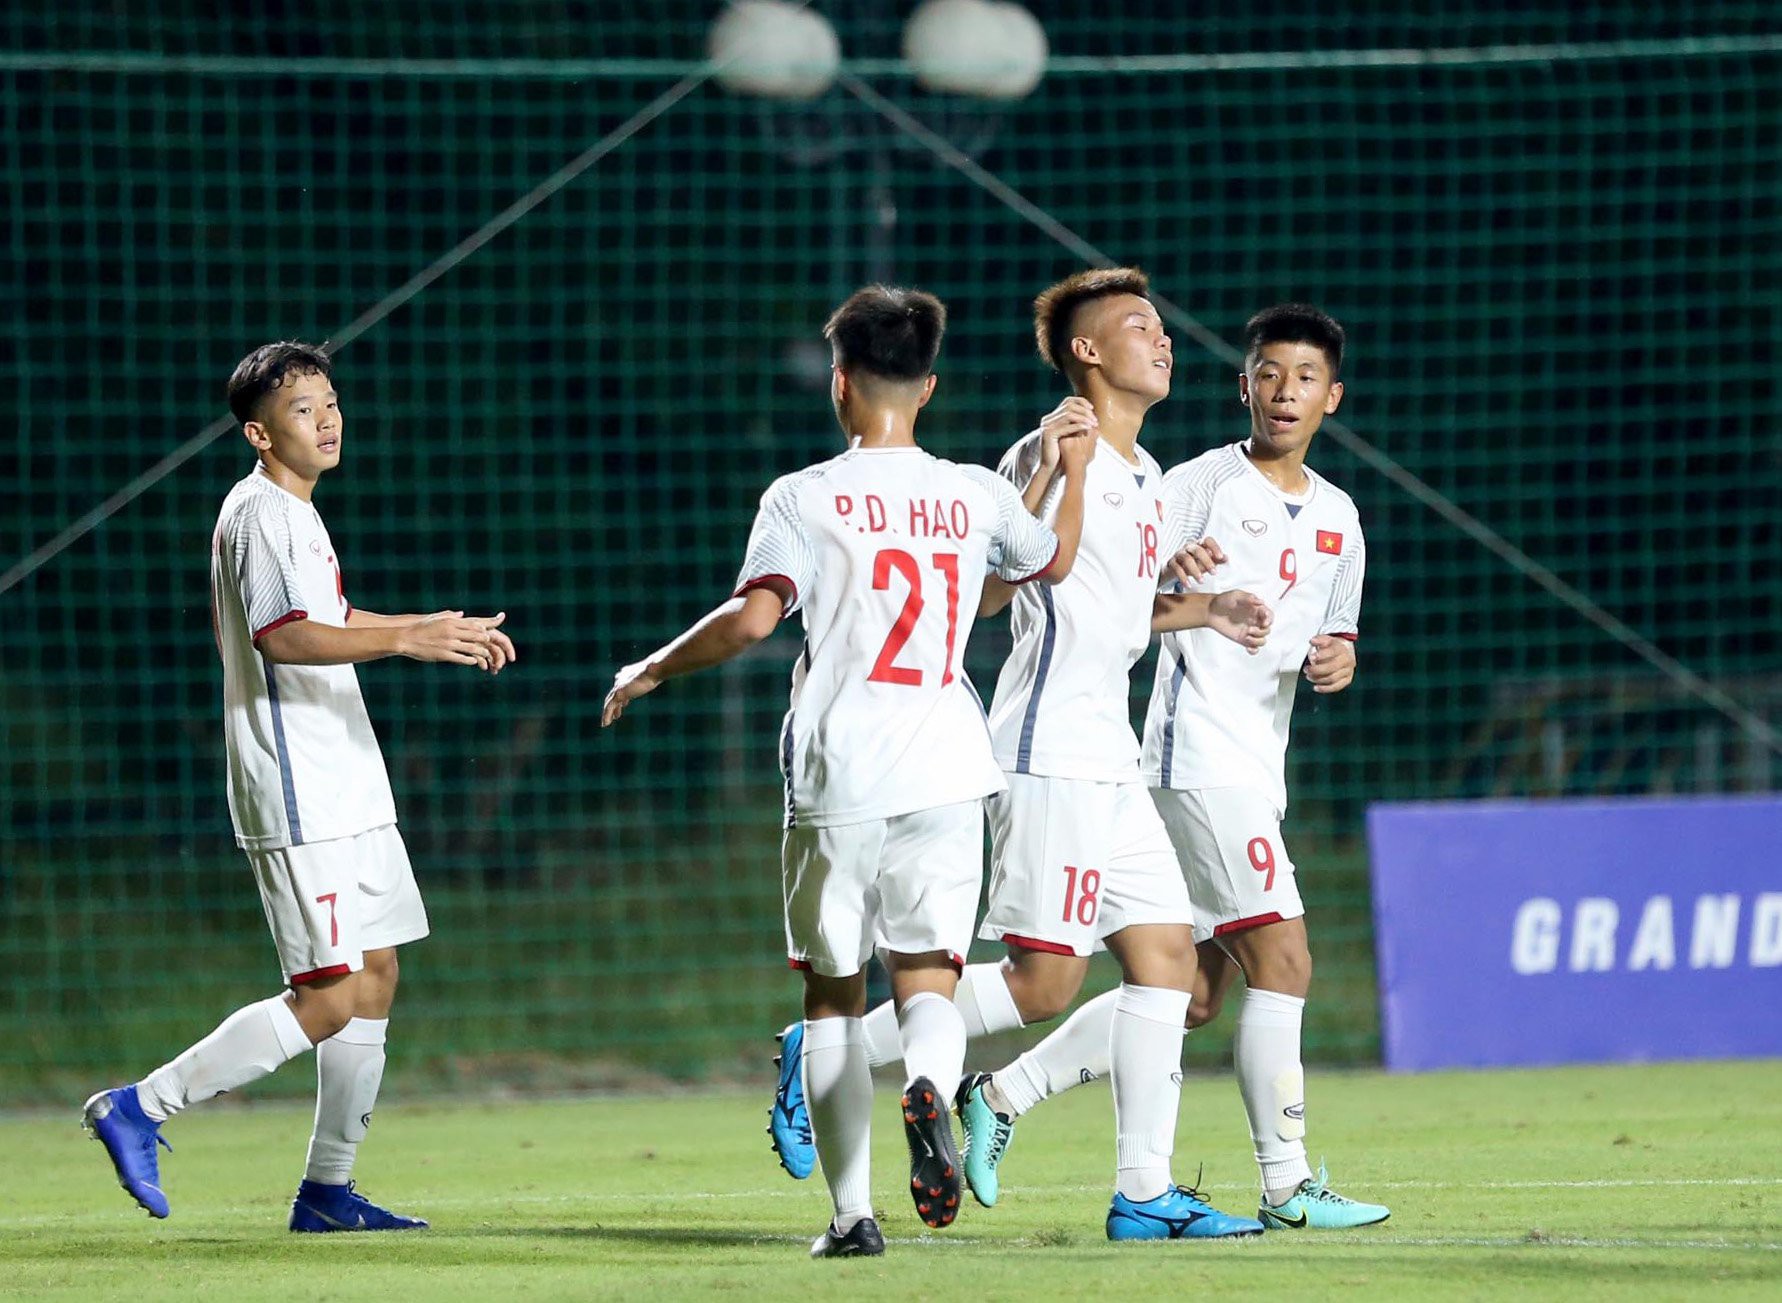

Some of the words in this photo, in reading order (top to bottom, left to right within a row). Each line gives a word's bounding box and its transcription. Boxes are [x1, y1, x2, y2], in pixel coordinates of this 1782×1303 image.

[909, 499, 969, 540] HAO
[1136, 521, 1158, 579] 18
[1279, 548, 1297, 600] 9
[867, 548, 960, 689] 21
[1247, 837, 1275, 892] 9
[316, 893, 338, 947] 7
[1062, 866, 1100, 926] 18
[1511, 892, 1782, 976] GRAND
